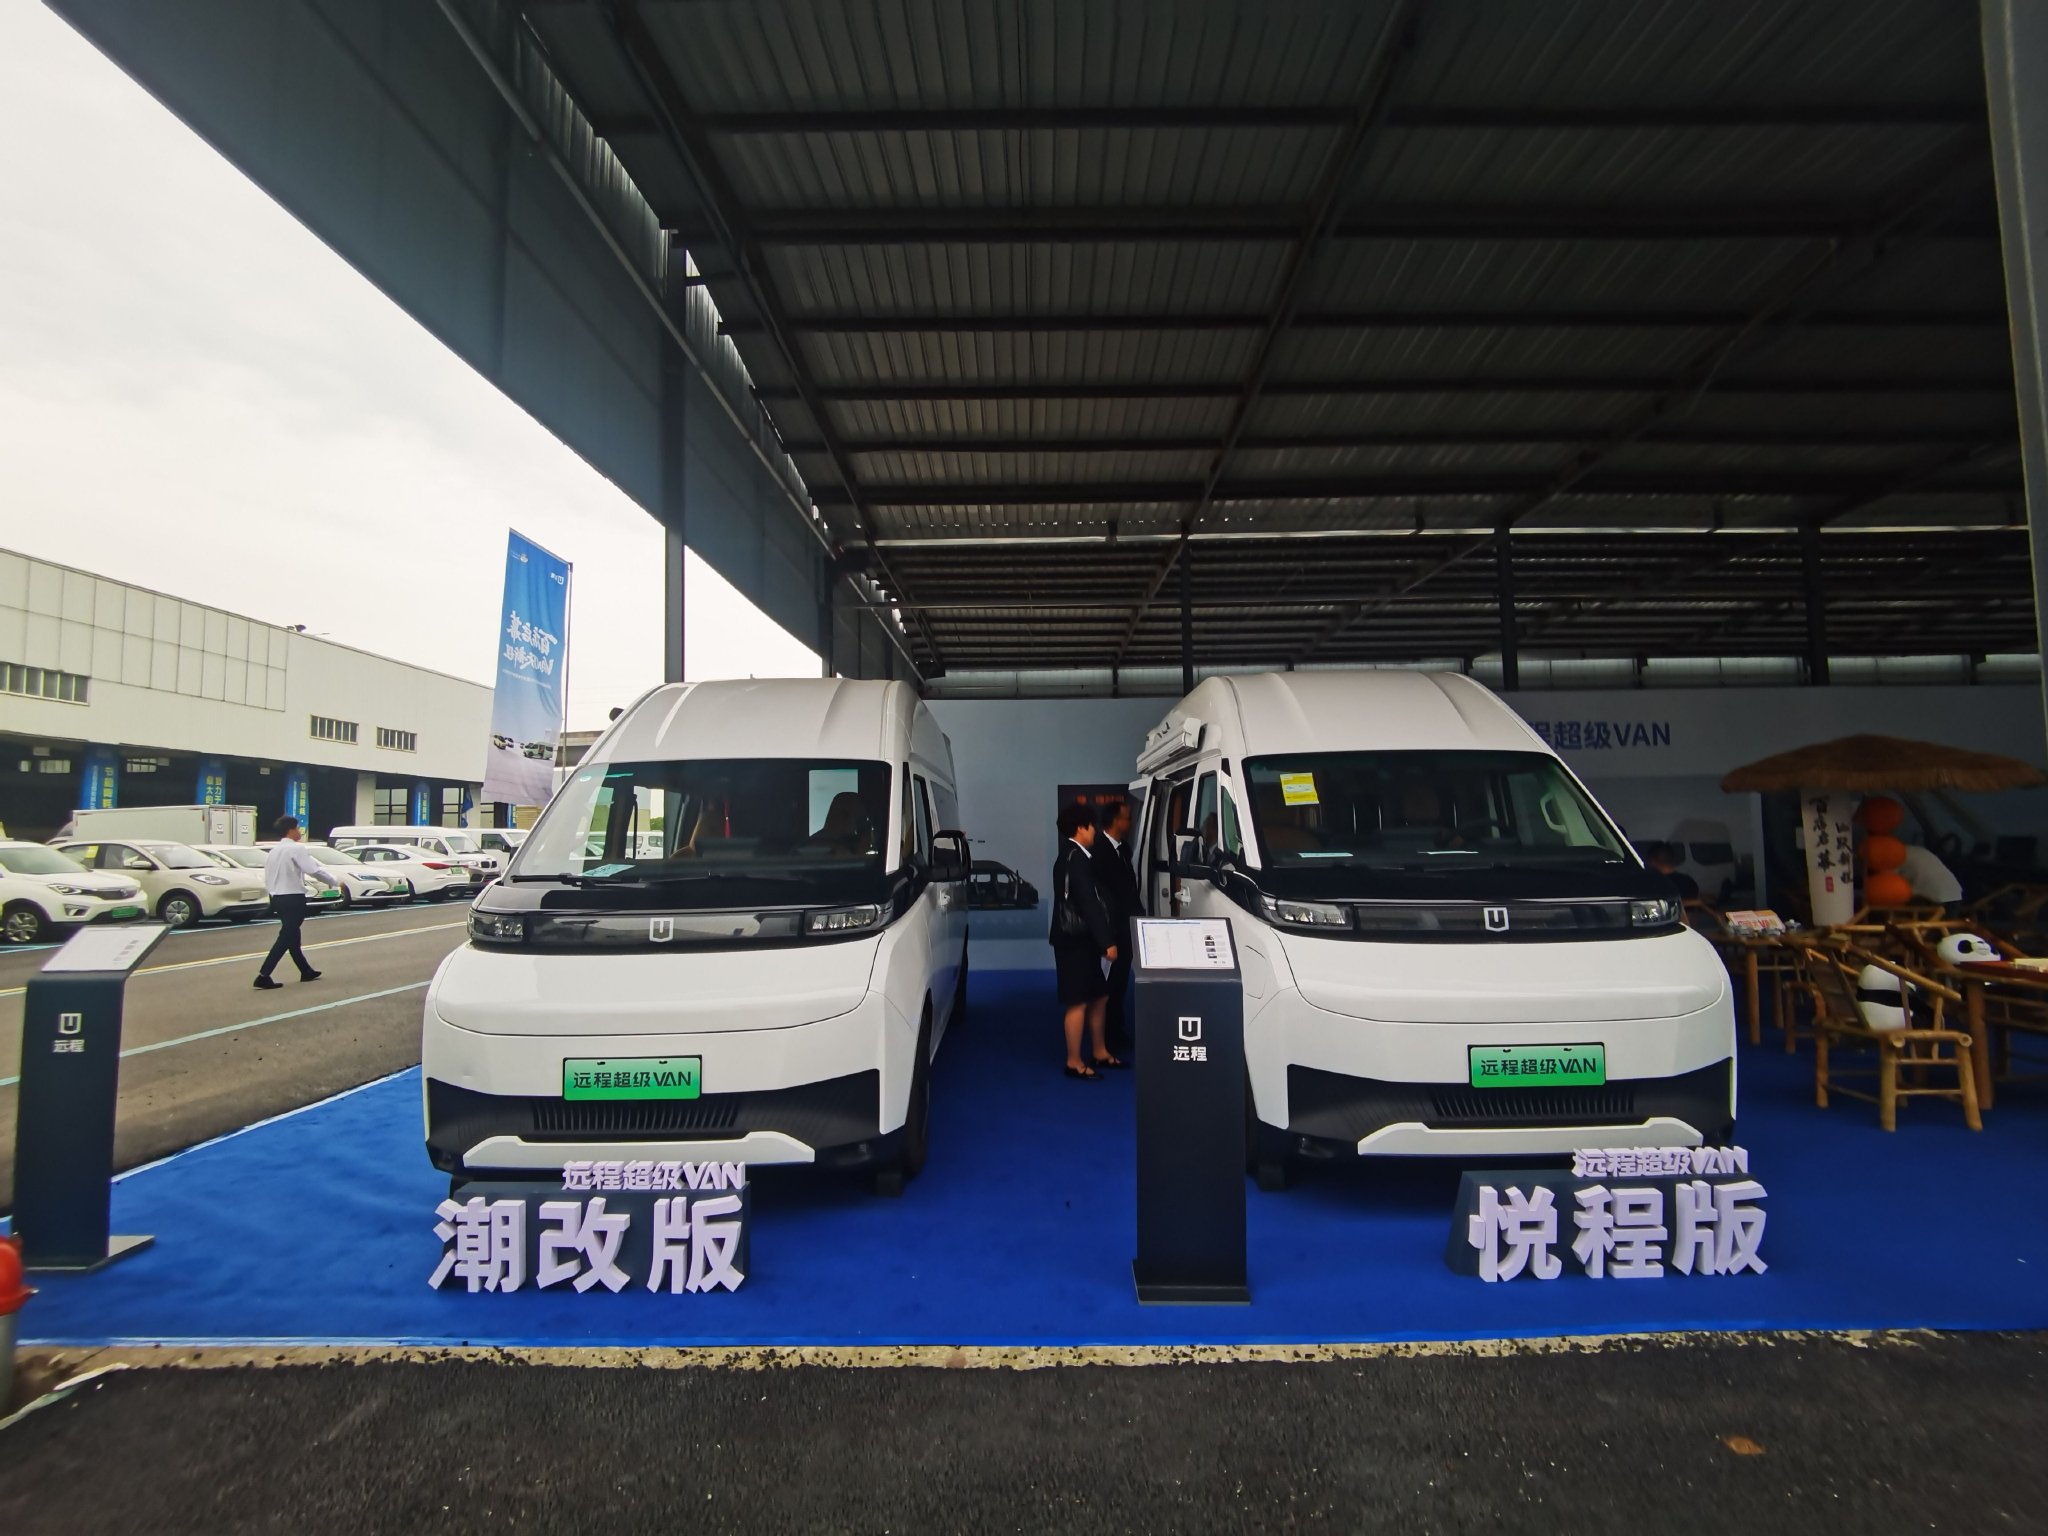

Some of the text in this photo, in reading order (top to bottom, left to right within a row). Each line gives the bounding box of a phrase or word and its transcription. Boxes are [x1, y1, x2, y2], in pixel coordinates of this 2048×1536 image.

[52, 1039, 85, 1053] 远程
[1173, 1045, 1208, 1062] 远程
[1480, 1057, 1597, 1076] 远程超级VAN
[573, 1071, 692, 1089] 远程超级VAN
[1572, 1146, 1749, 1178] 远程超级VAN
[562, 1160, 746, 1191] 远程超级VAN
[428, 1194, 745, 1294] 潮改版
[1468, 1180, 1768, 1283] 悦程版
